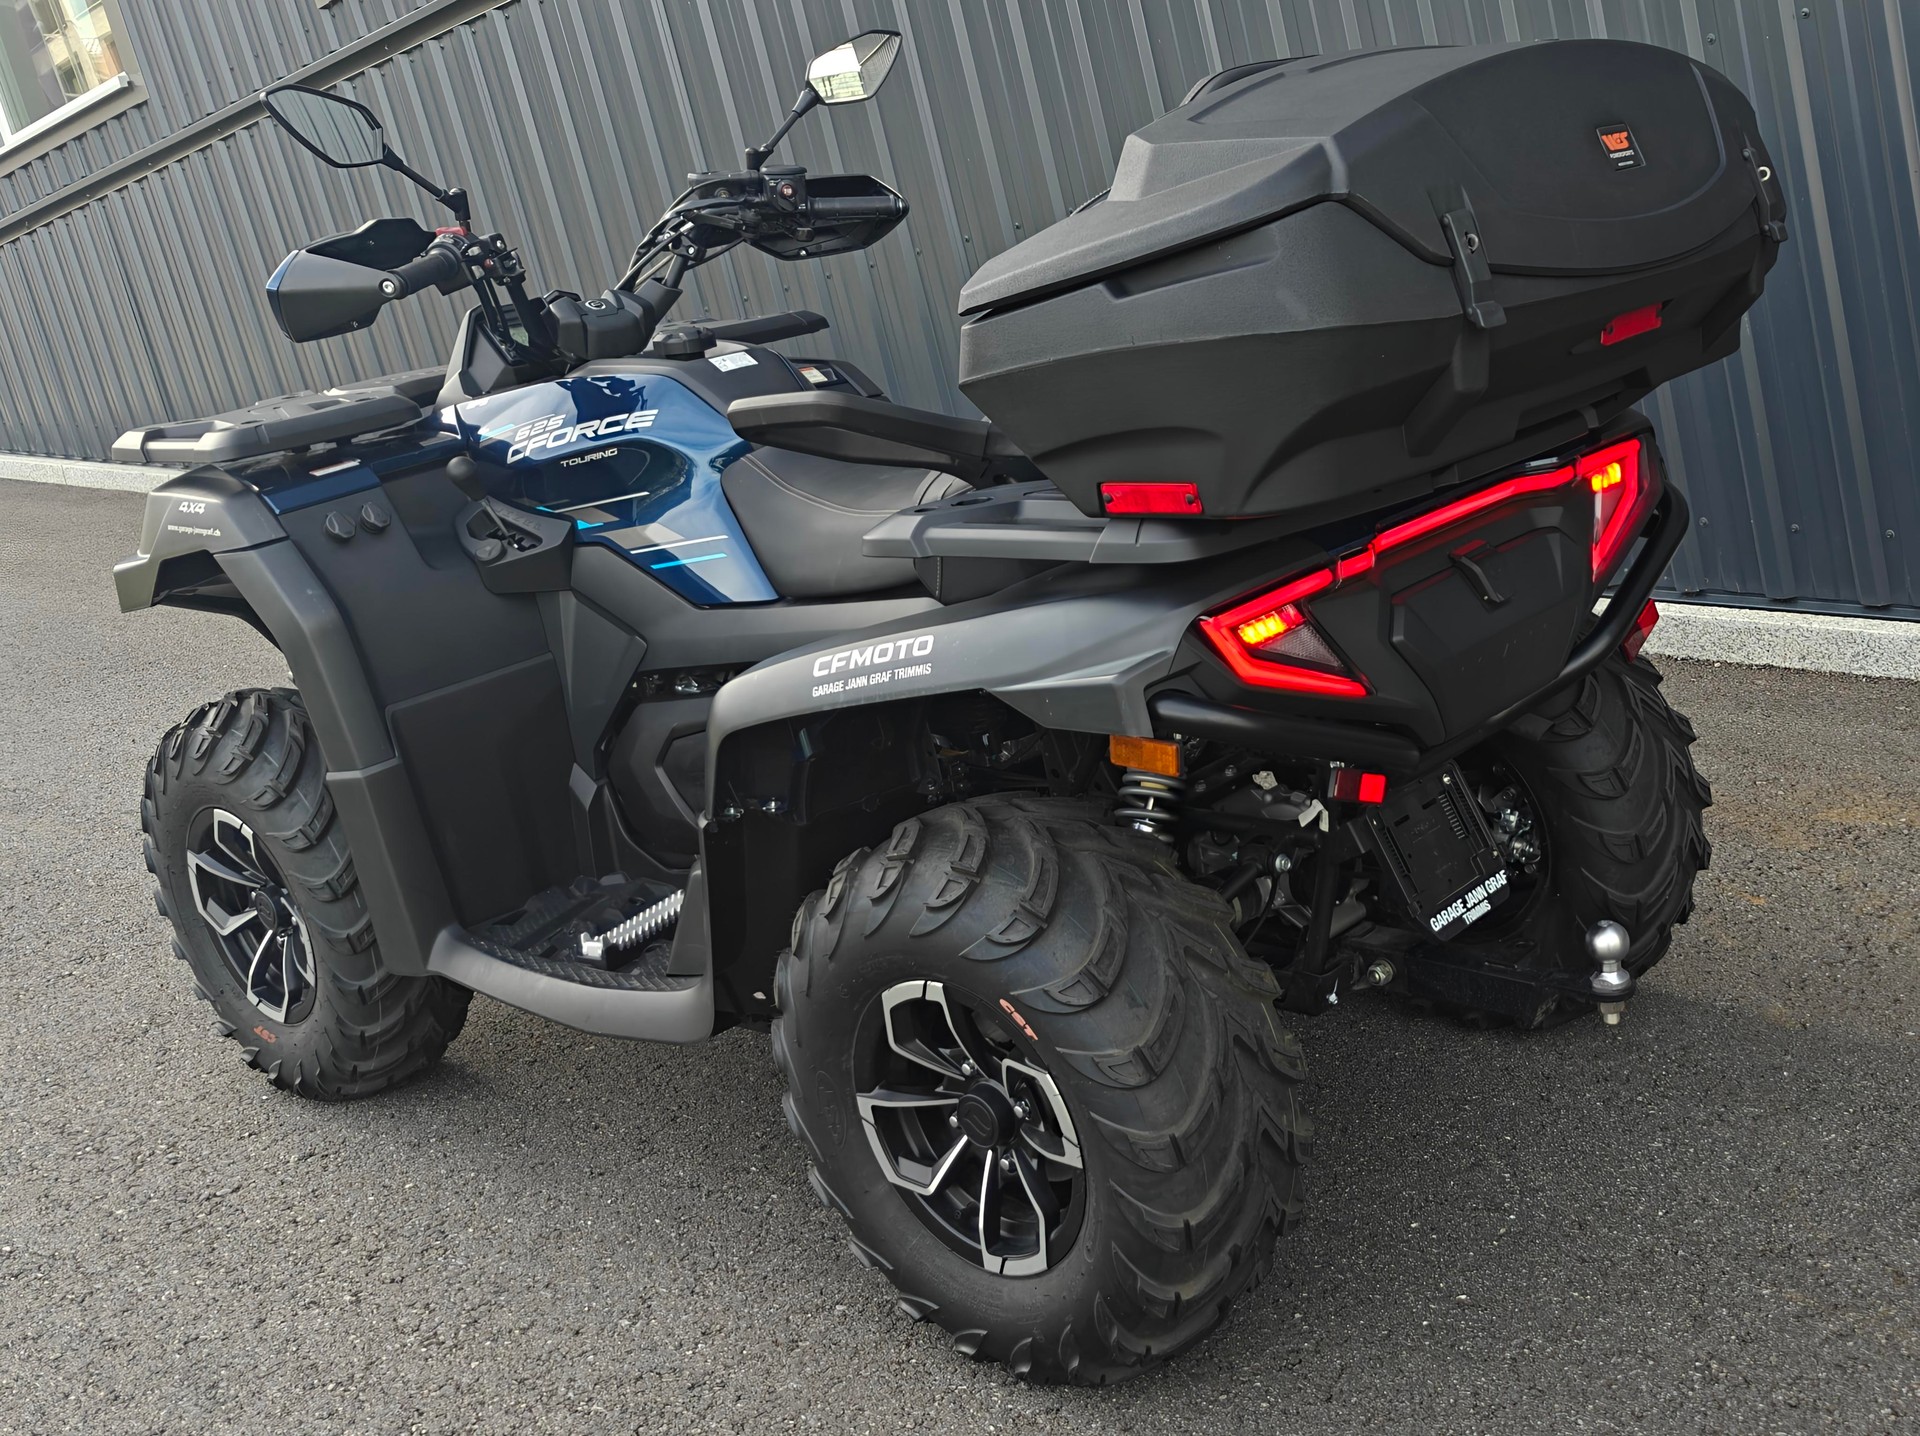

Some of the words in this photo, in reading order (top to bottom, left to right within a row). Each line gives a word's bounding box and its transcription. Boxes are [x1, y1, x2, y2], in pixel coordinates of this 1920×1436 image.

[506, 409, 659, 464] CFORCE
[515, 413, 566, 442] 625
[560, 447, 618, 468] TOURING
[812, 634, 935, 678] CFMOTO
[812, 680, 844, 697] GARAGE
[845, 675, 868, 690] JANN
[869, 670, 893, 685] GRAF
[894, 662, 932, 680] TRIMMIS
[1430, 898, 1467, 932] GARAGE
[1464, 884, 1488, 908] JANN
[1484, 869, 1507, 894] GRAF
[1462, 899, 1491, 925] TRIMMIS
